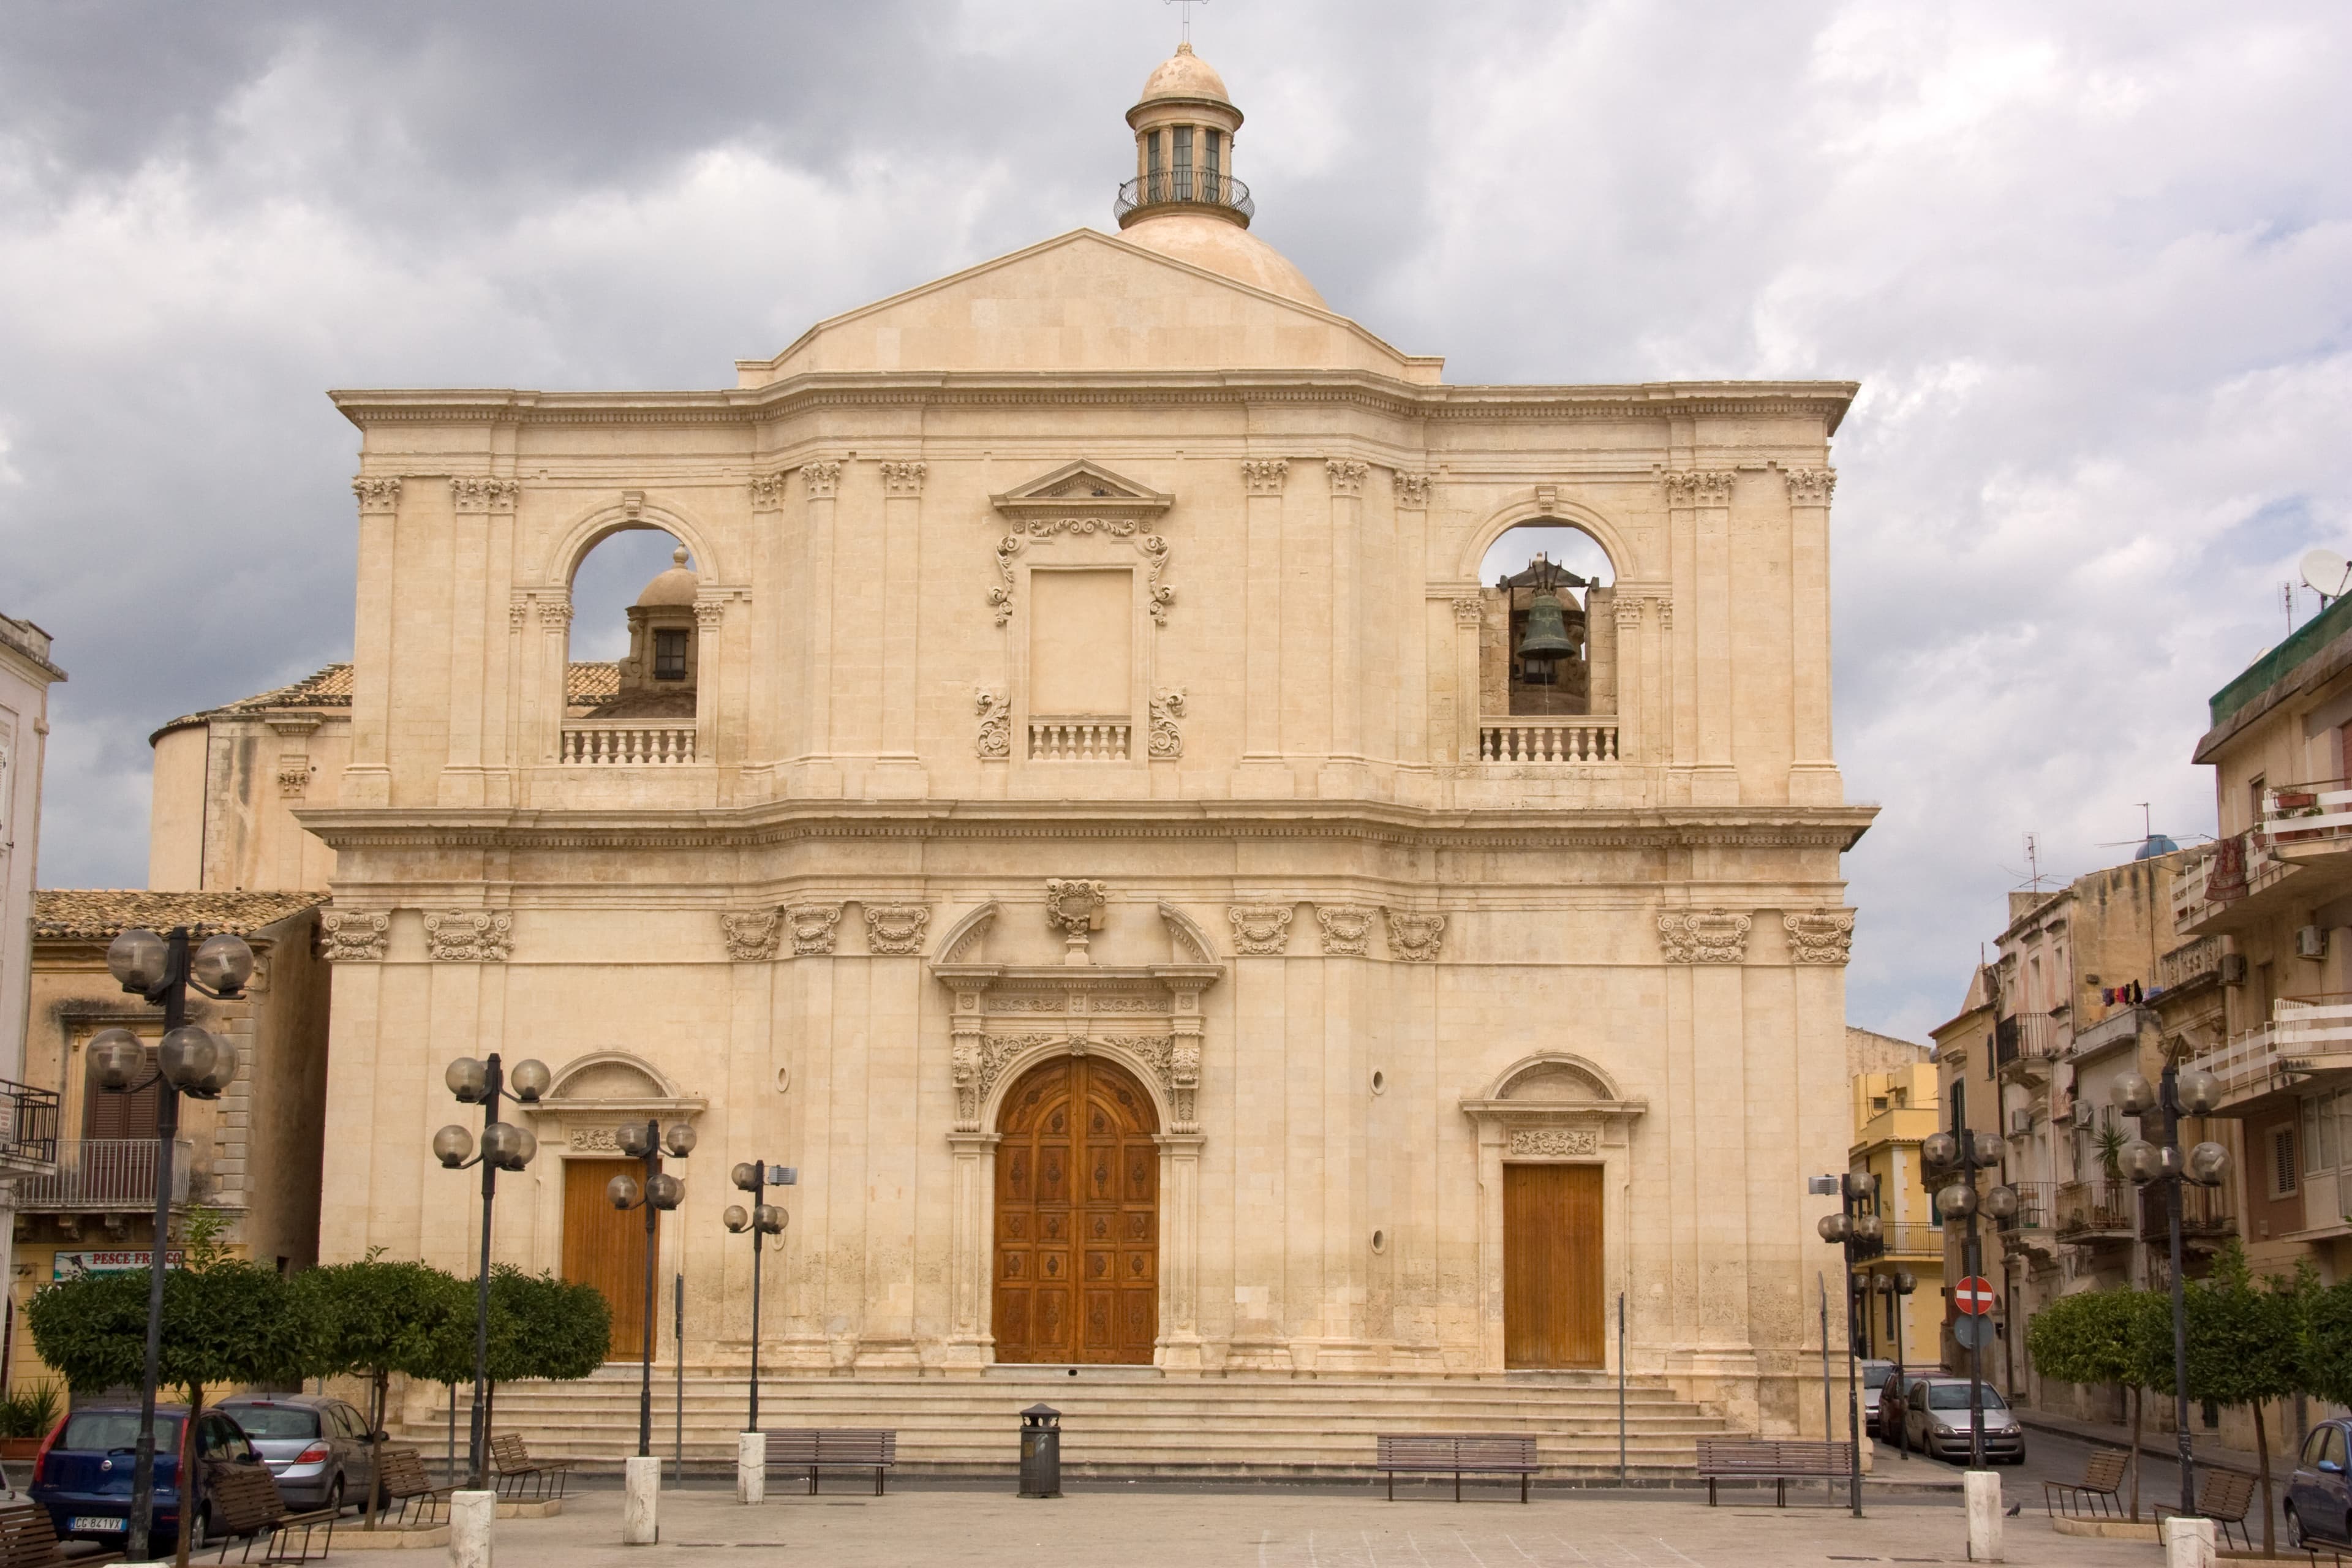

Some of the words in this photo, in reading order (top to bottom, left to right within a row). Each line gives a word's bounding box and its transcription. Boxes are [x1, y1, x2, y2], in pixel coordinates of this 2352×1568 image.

[92, 1253, 130, 1264] PESCE
[134, 1253, 181, 1264] FRCO
[90, 1518, 121, 1529] 841VX
